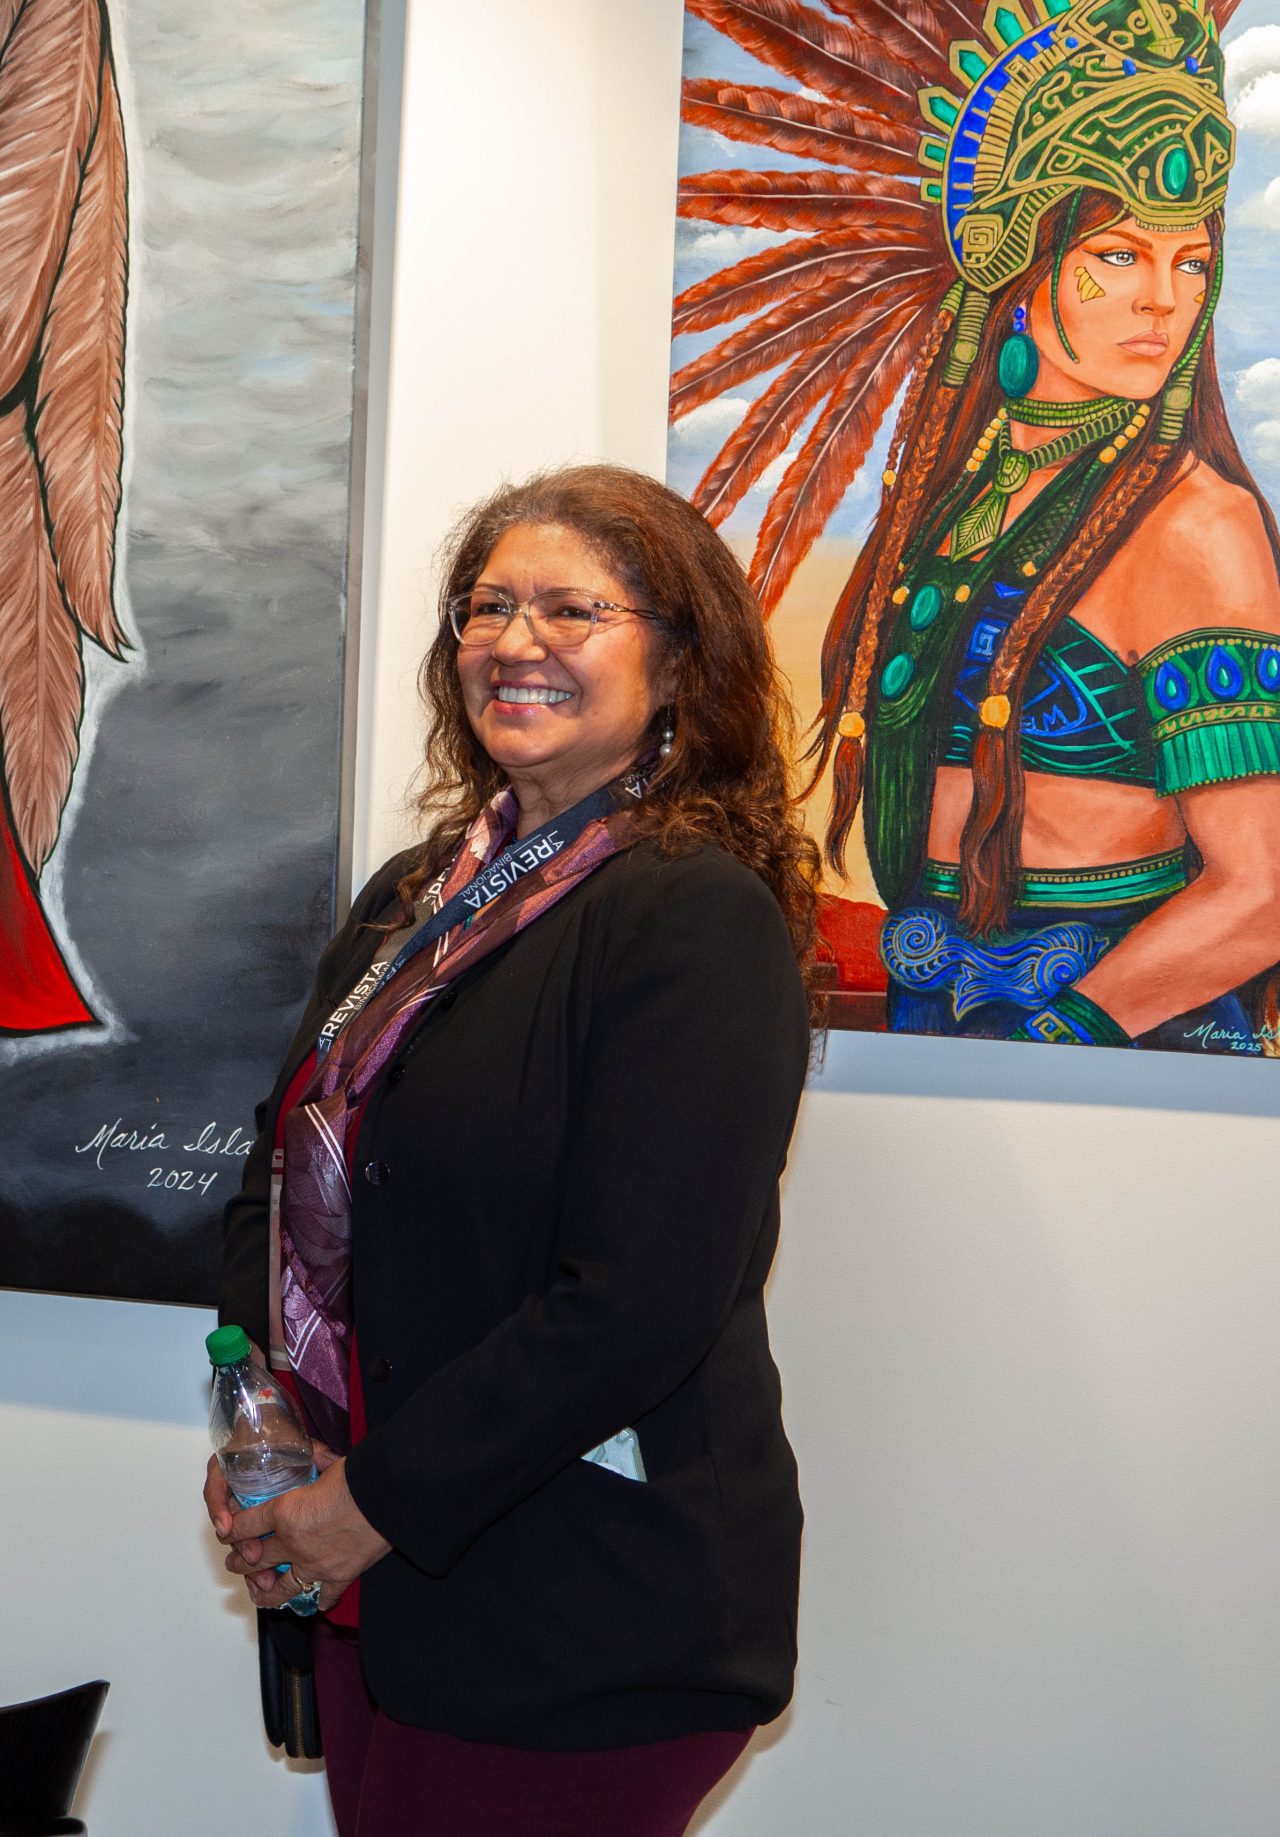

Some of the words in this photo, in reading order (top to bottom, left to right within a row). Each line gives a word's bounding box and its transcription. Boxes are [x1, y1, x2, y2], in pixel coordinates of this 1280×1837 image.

[546, 830, 565, 851] LA
[460, 852, 513, 898] BINACIONAL
[463, 838, 554, 909] REVISTA
[321, 960, 388, 1037] REVISTA
[1230, 1040, 1263, 1053] 2025
[1252, 1024, 1280, 1041] Is
[146, 1167, 218, 1196] 2024
